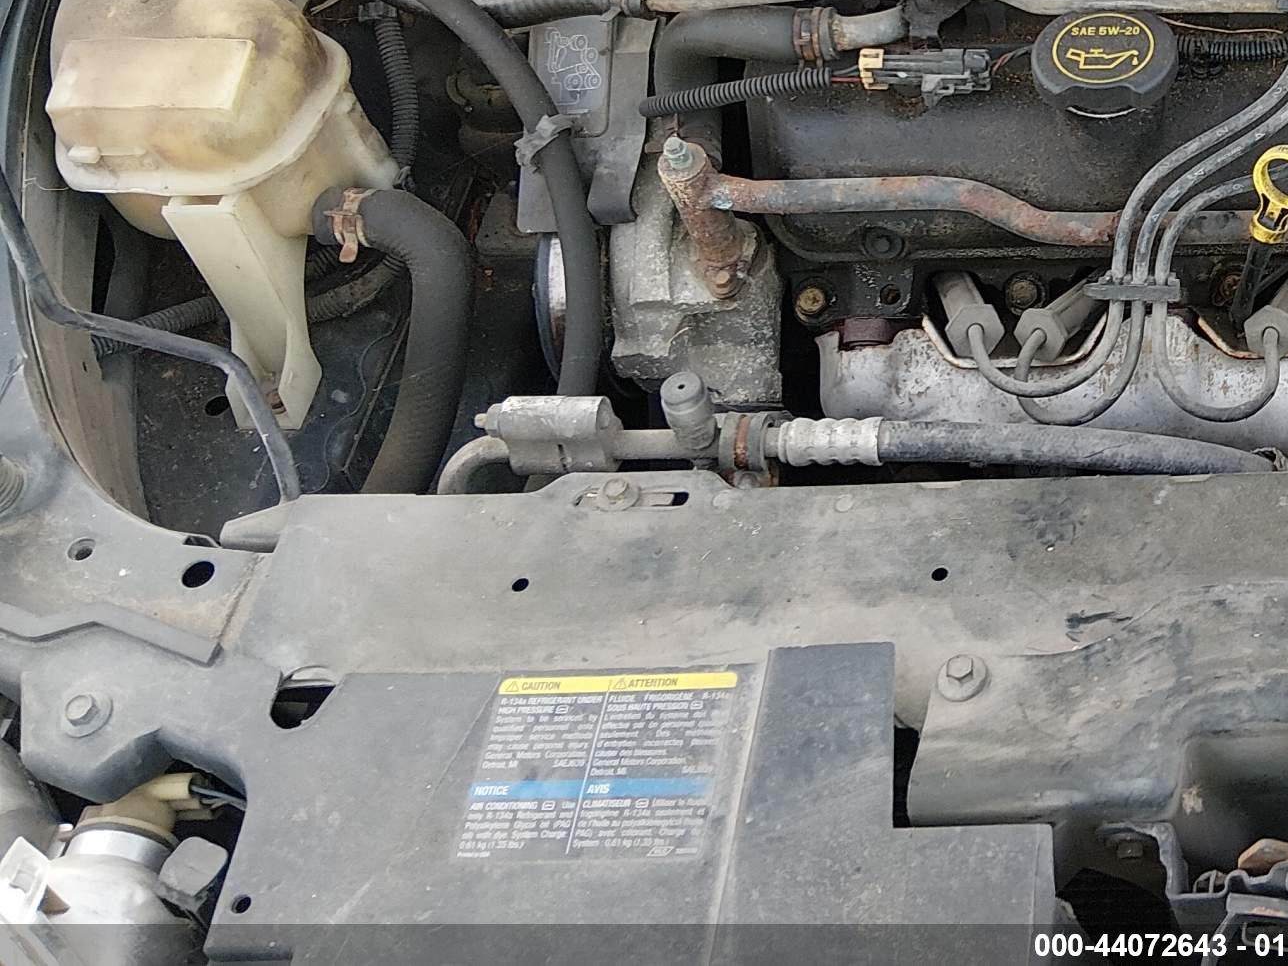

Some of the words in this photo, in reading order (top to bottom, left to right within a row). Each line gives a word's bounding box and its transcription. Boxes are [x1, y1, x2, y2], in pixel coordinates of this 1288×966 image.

[1071, 26, 1096, 36] SAE
[1099, 26, 1140, 36] 5W-20
[521, 681, 561, 691] CAUTION
[628, 677, 679, 688] ATTENTION
[474, 785, 510, 795] NOTICE
[586, 784, 611, 794] AVIS
[469, 802, 484, 811] AIR
